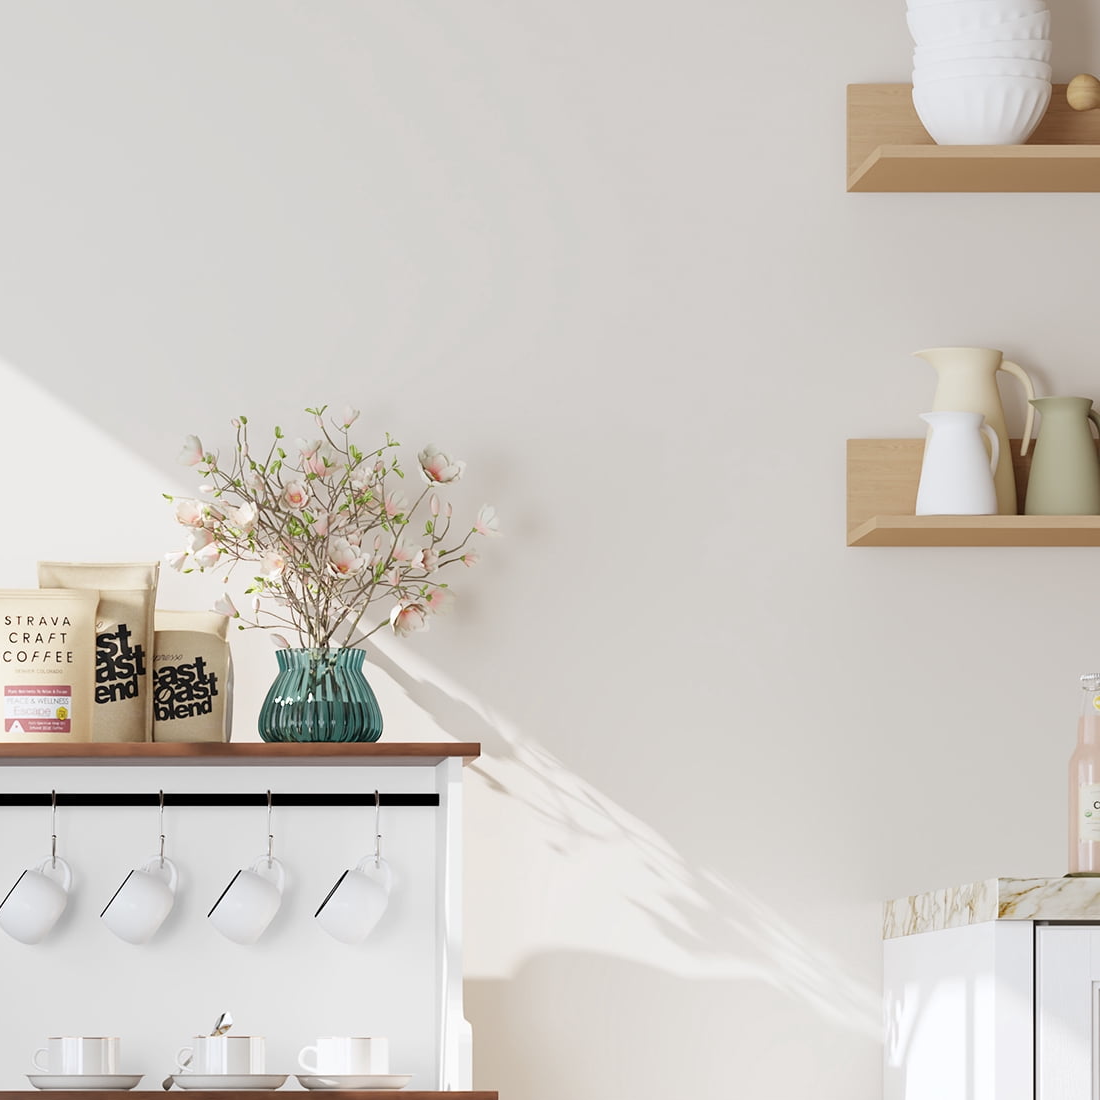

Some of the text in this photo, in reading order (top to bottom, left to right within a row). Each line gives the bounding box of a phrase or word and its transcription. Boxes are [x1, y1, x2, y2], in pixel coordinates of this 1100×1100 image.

[4, 616, 71, 626] STRAVA
[8, 632, 67, 644] CRAFT
[96, 624, 132, 657] st
[2, 650, 73, 663] COFFEE
[96, 644, 146, 683] ast
[95, 674, 138, 704] end
[154, 672, 218, 704] oast
[154, 694, 212, 721] blend
